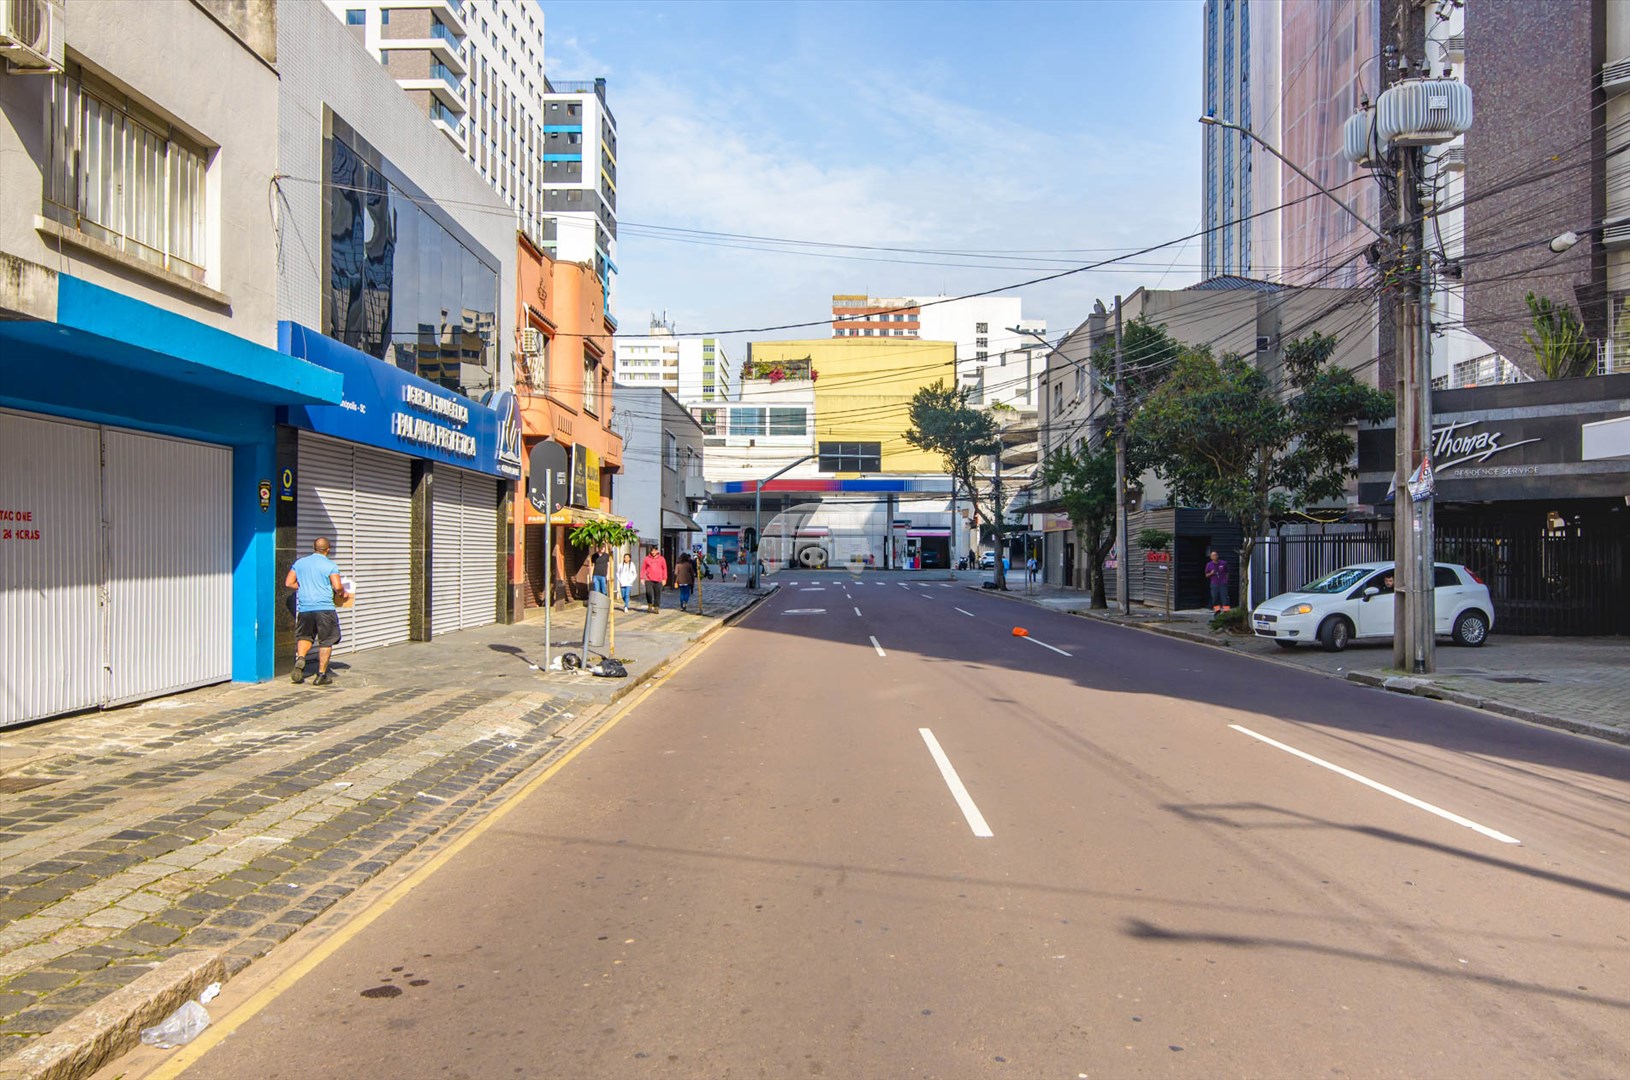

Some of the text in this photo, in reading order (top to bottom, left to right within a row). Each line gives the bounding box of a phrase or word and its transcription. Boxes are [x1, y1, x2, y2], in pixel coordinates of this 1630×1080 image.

[1431, 420, 1508, 463] Thomas
[1455, 466, 1540, 477] RESIDENCE SERVICE
